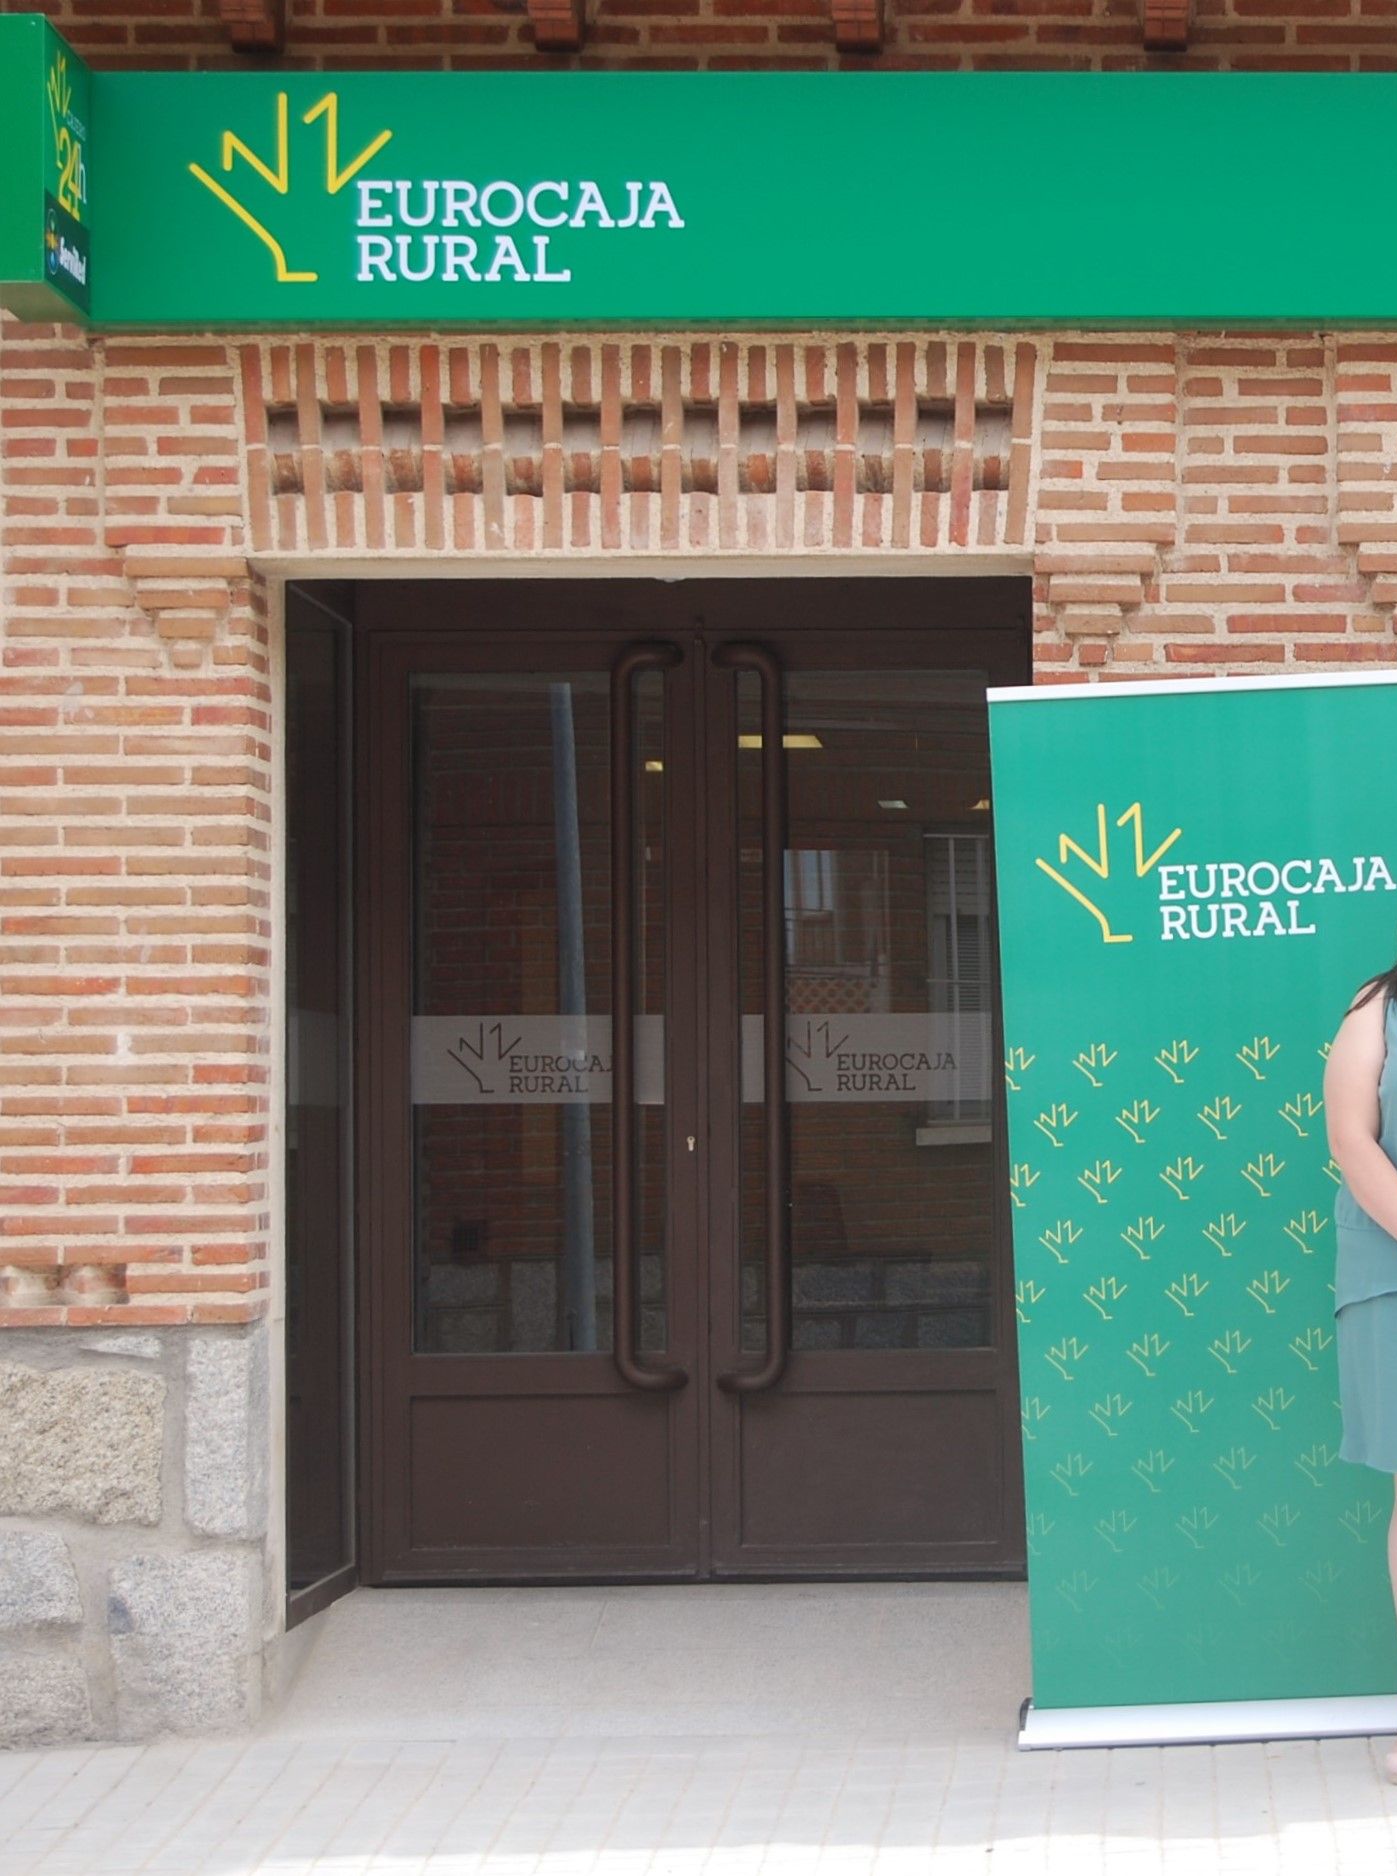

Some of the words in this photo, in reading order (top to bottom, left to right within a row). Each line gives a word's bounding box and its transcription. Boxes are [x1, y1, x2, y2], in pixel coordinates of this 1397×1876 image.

[357, 180, 685, 228] EUROCAJA
[357, 235, 571, 282] RURAL
[1158, 856, 1397, 900] EUROCAJA
[1160, 900, 1316, 940] RURAL
[509, 1055, 612, 1073] EUROCA
[837, 1053, 957, 1071] EUROCAJA
[509, 1076, 588, 1093] RURAL
[837, 1074, 916, 1091] RURAL
